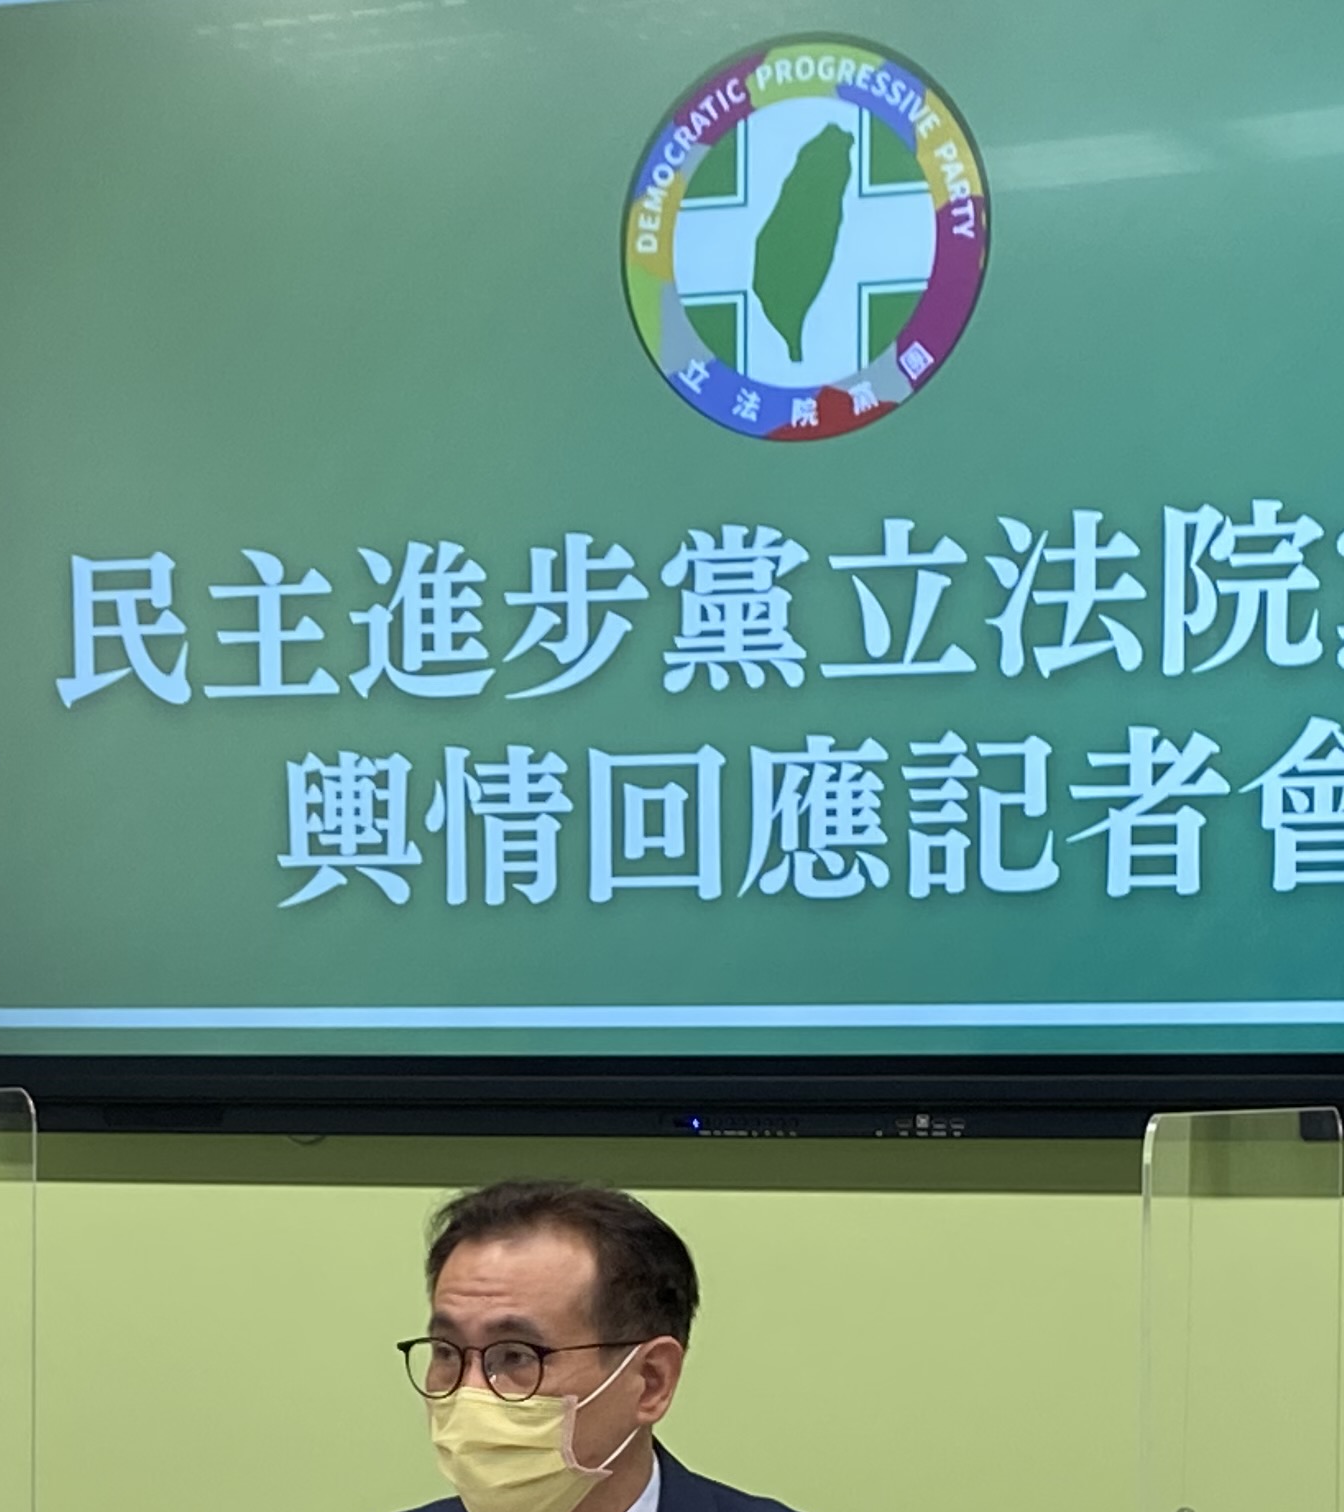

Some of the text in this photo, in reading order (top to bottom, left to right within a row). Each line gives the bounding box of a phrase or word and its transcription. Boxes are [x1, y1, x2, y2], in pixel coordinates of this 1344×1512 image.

[637, 55, 975, 253] DEMOCRATIC PROGRESSIVE PARTY
